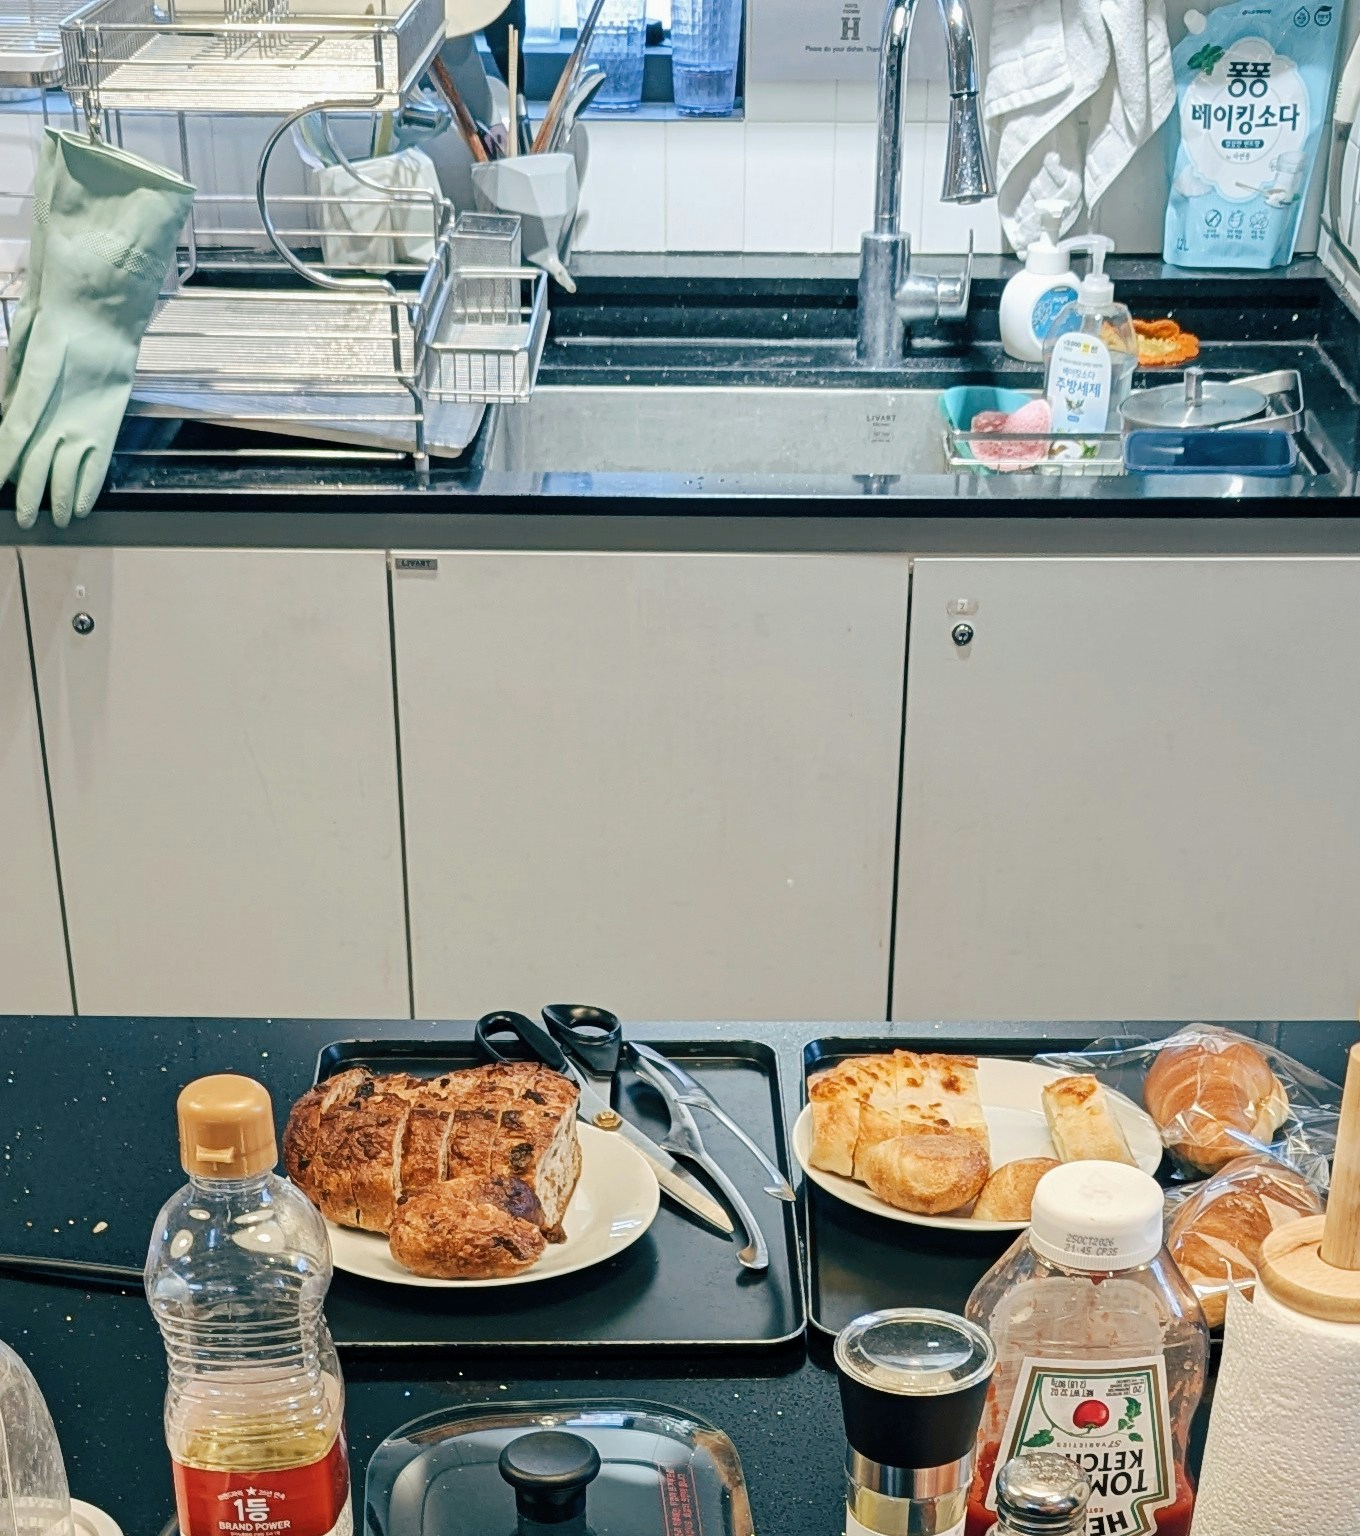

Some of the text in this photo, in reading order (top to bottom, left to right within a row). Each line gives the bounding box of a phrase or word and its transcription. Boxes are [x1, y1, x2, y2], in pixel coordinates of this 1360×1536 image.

[840, 17, 861, 40] H
[1226, 61, 1272, 98] 퐁퐁
[1191, 103, 1301, 136] 베이킹소다
[1062, 367, 1096, 380] 베이킹소다
[1055, 376, 1102, 398] 주방세제
[1069, 1388, 1080, 1397] WT
[1081, 1388, 1094, 1397] NET
[1107, 1440, 1122, 1448] 57
[1090, 1469, 1148, 1497] TOM
[233, 1498, 270, 1522] 1등
[218, 1520, 291, 1532] BRAND POWER
